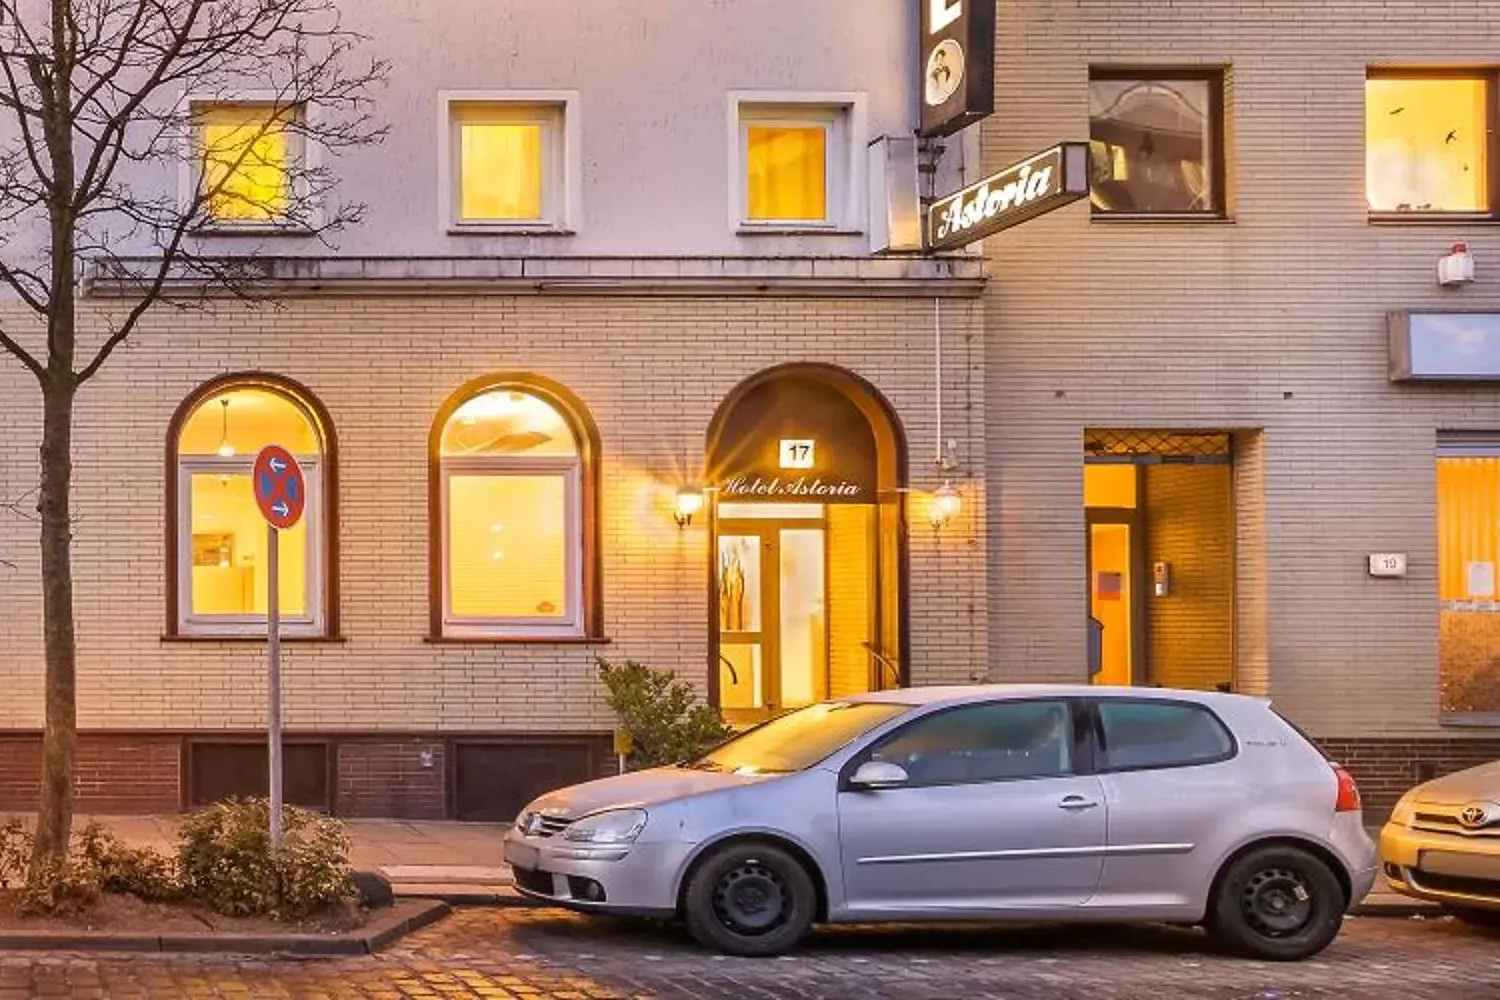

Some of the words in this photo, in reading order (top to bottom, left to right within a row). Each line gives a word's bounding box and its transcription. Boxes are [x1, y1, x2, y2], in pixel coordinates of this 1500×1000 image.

[937, 164, 1053, 239] Astoria
[788, 445, 811, 461] 17
[722, 476, 785, 495] Hotel
[785, 475, 861, 496] Astoria
